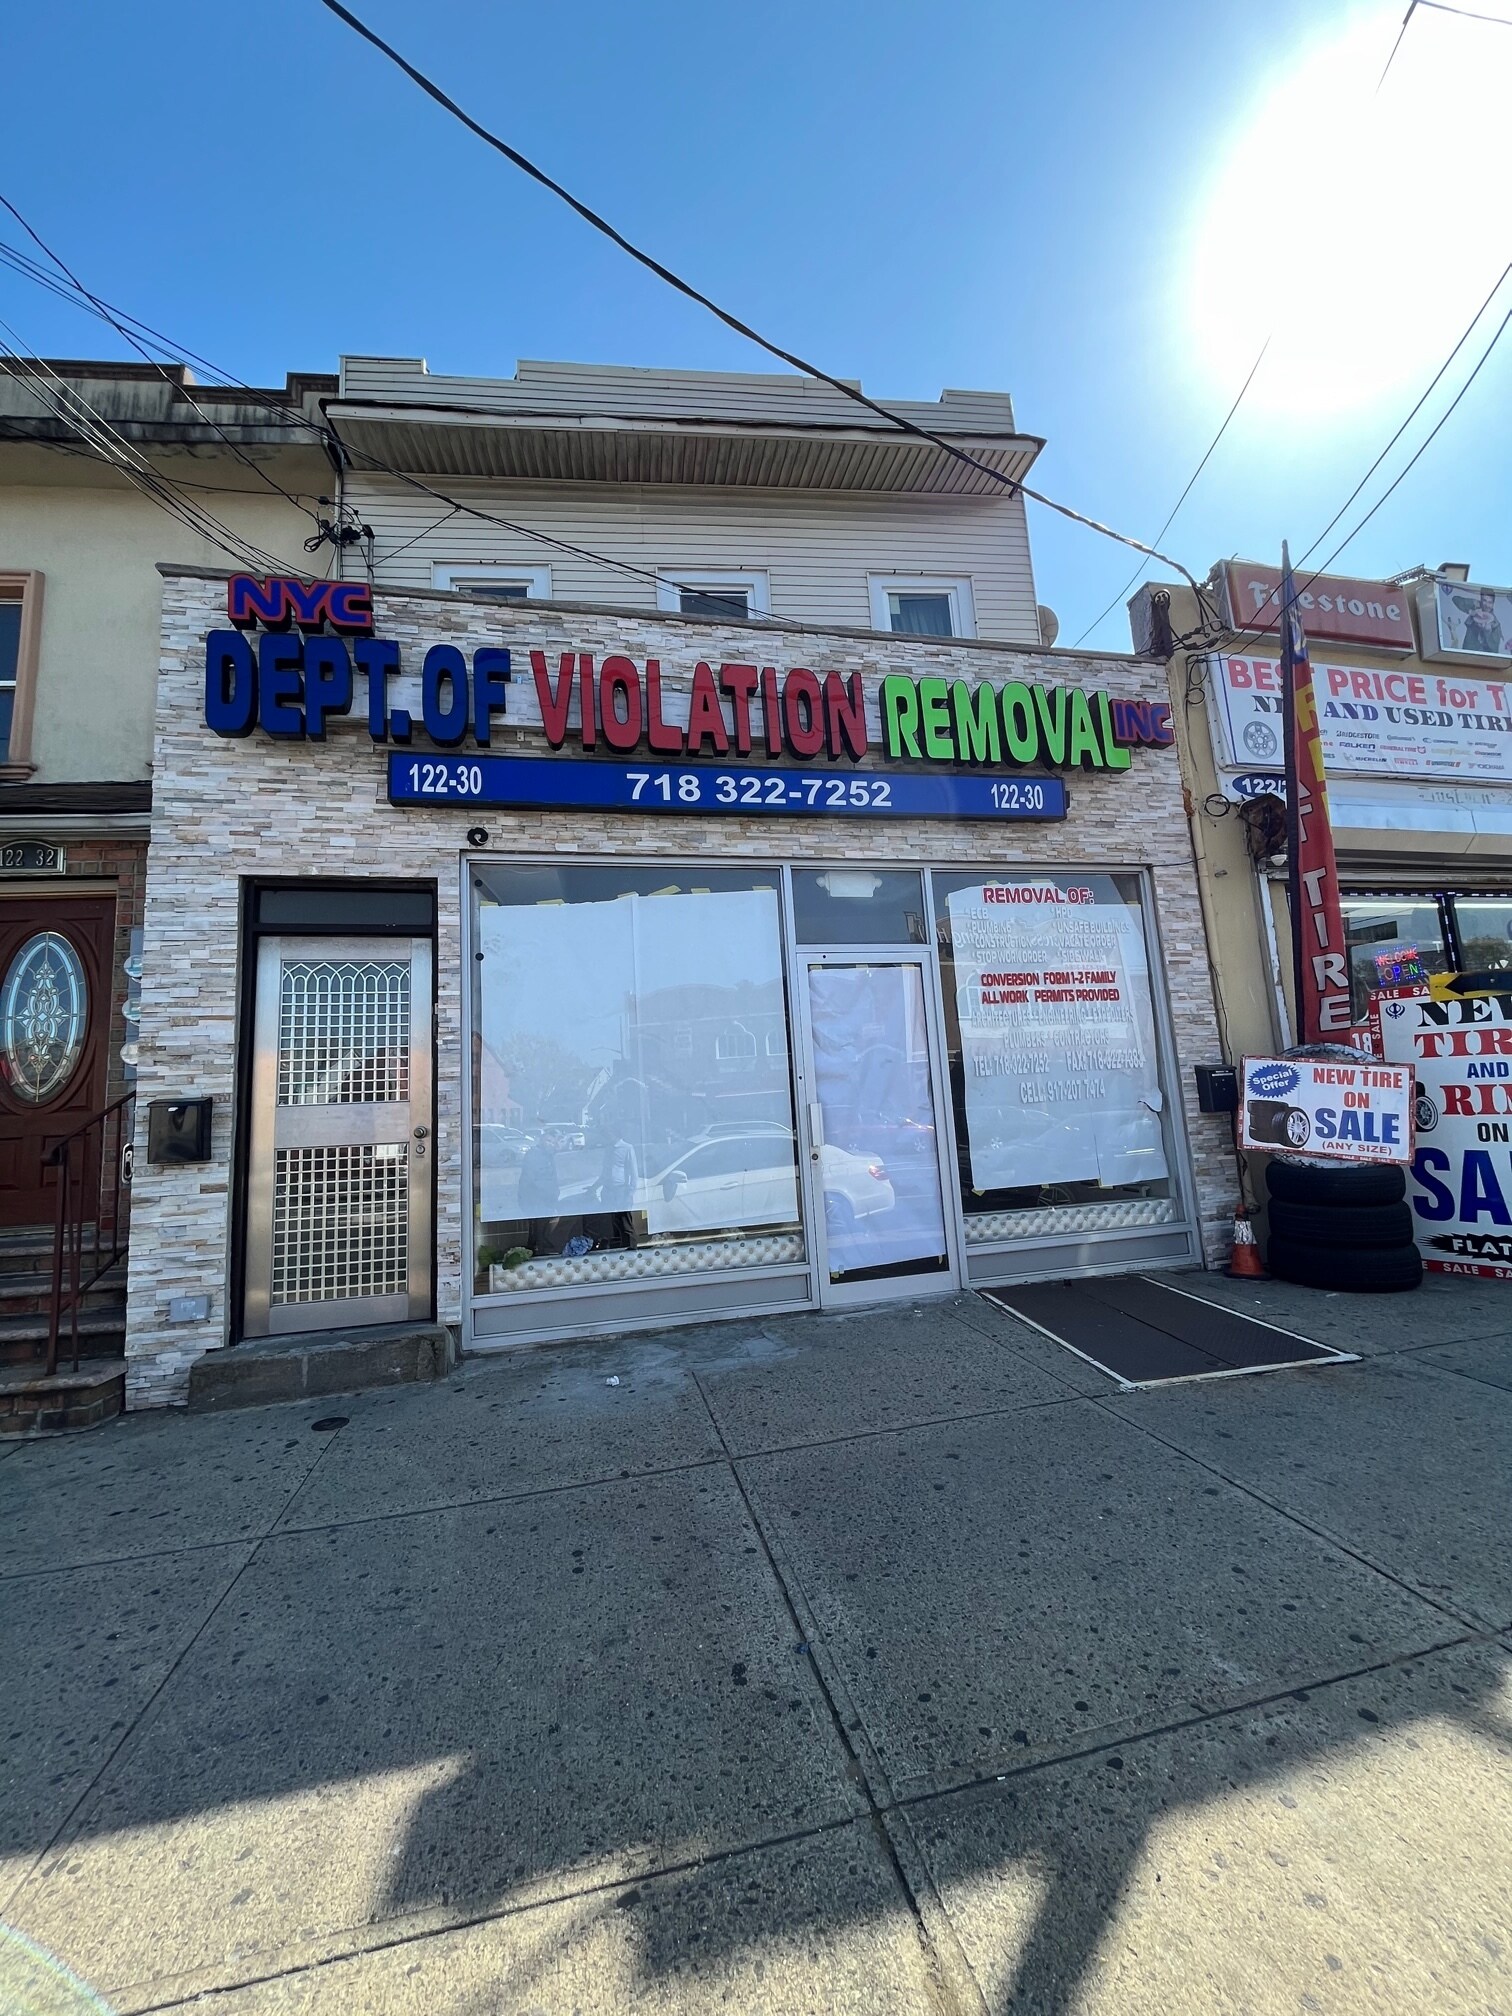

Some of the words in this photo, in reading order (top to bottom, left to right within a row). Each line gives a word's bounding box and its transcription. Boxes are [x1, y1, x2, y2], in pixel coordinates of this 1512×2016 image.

[228, 573, 373, 630] NYC
[1248, 581, 1401, 621] Fiestone
[1227, 659, 1315, 692] BE
[1327, 667, 1428, 706] PRICE
[1436, 678, 1479, 709] for
[422, 644, 511, 748] OF
[529, 649, 868, 763] VIOLATION
[881, 674, 1132, 774] REMOVAL
[1109, 699, 1174, 748] INC
[1324, 701, 1379, 721] AND
[1383, 706, 1454, 728] USED
[409, 763, 482, 795] 122-30
[626, 773, 701, 802] 718
[715, 776, 892, 807] 322-7252
[991, 784, 1043, 810] 122-30
[36, 850, 54, 866] 32
[983, 887, 1065, 904] REMOVAL
[1067, 888, 1095, 904] OF:
[970, 907, 990, 920] ECB
[972, 921, 1012, 934] PLUMBING
[1057, 921, 1089, 934] UNSAFE
[1090, 920, 1130, 934] BUILDINGS
[975, 934, 1032, 949] CONSTRUCTION
[1058, 934, 1090, 949] VACATE
[1303, 866, 1351, 1031] TIRE
[976, 951, 997, 963] STOP
[997, 950, 1022, 963] WORK
[1022, 950, 1048, 963] ORDER
[981, 972, 1040, 987] CONVERSION
[1043, 971, 1070, 985] FORM
[1070, 971, 1085, 985] 1-2
[1085, 970, 1117, 984] FAMILY
[1384, 963, 1419, 980] OPEN
[981, 990, 1000, 1004] ALL
[1000, 989, 1030, 1004] WORK
[1034, 988, 1075, 1003] PERMITS
[1075, 988, 1120, 1002] PROVIDED
[1370, 989, 1399, 1001] SALE
[1369, 1013, 1381, 1040] SALE
[973, 1055, 993, 1077] TEL:
[1467, 1062, 1509, 1079] AND
[1252, 1069, 1293, 1086] Special
[1313, 1067, 1356, 1086] NEW
[1360, 1070, 1403, 1089] TIRE
[1262, 1079, 1289, 1092] Offer
[1343, 1091, 1370, 1109] ON
[1315, 1108, 1401, 1145] SALE
[1477, 1122, 1509, 1143] ON
[1322, 1140, 1353, 1151] (ANY
[1358, 1144, 1392, 1156] SIZE)
[1409, 1147, 1512, 1226] SA
[1452, 1239, 1512, 1256] FLAT
[1443, 1262, 1479, 1275] SALE
